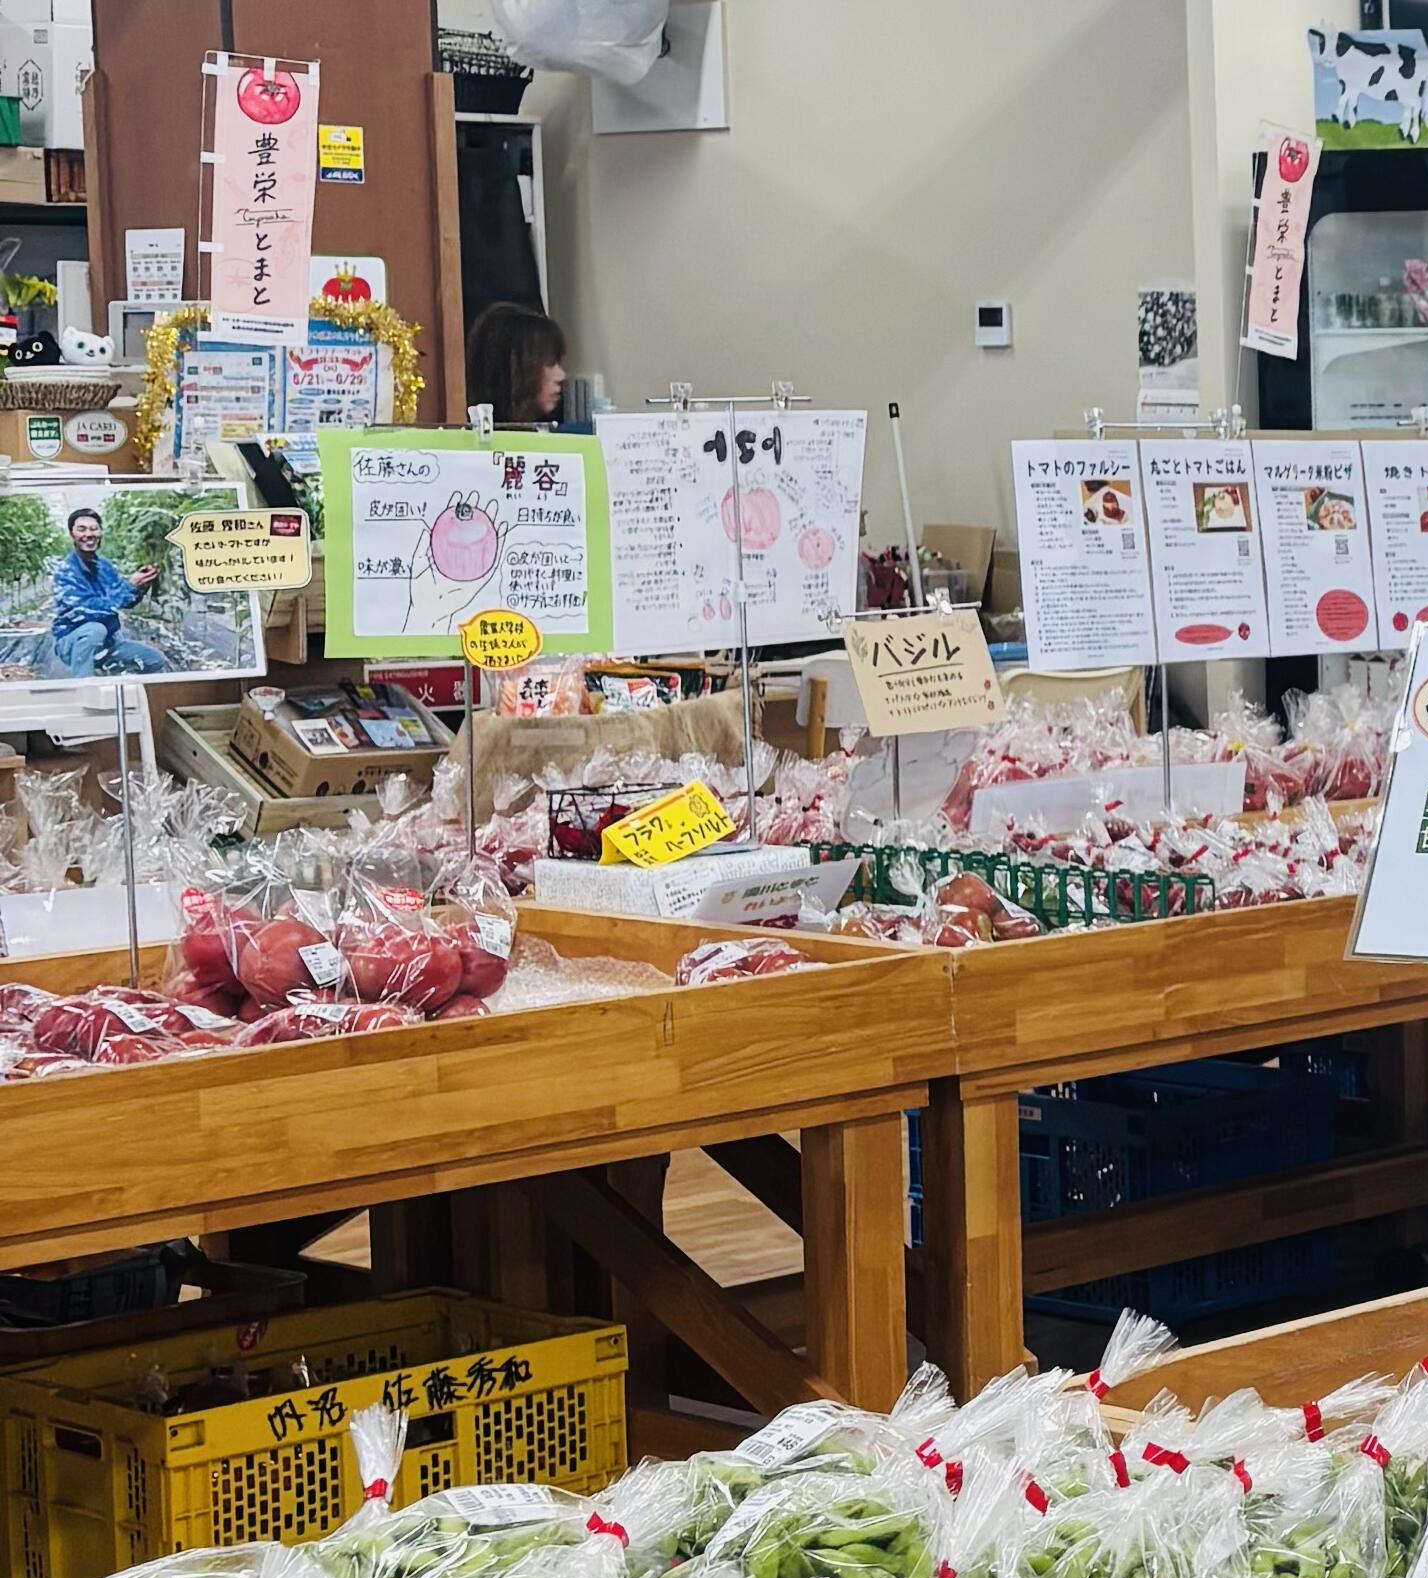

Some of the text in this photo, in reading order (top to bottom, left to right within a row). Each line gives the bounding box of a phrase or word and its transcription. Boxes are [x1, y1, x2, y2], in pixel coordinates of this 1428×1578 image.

[253, 232, 273, 306] とまと
[354, 455, 431, 478] 佐藤さんの
[1027, 459, 1131, 477] トマトのファルシー
[1150, 458, 1247, 476] 丸ごとトマトごはん
[872, 632, 960, 667] バジル
